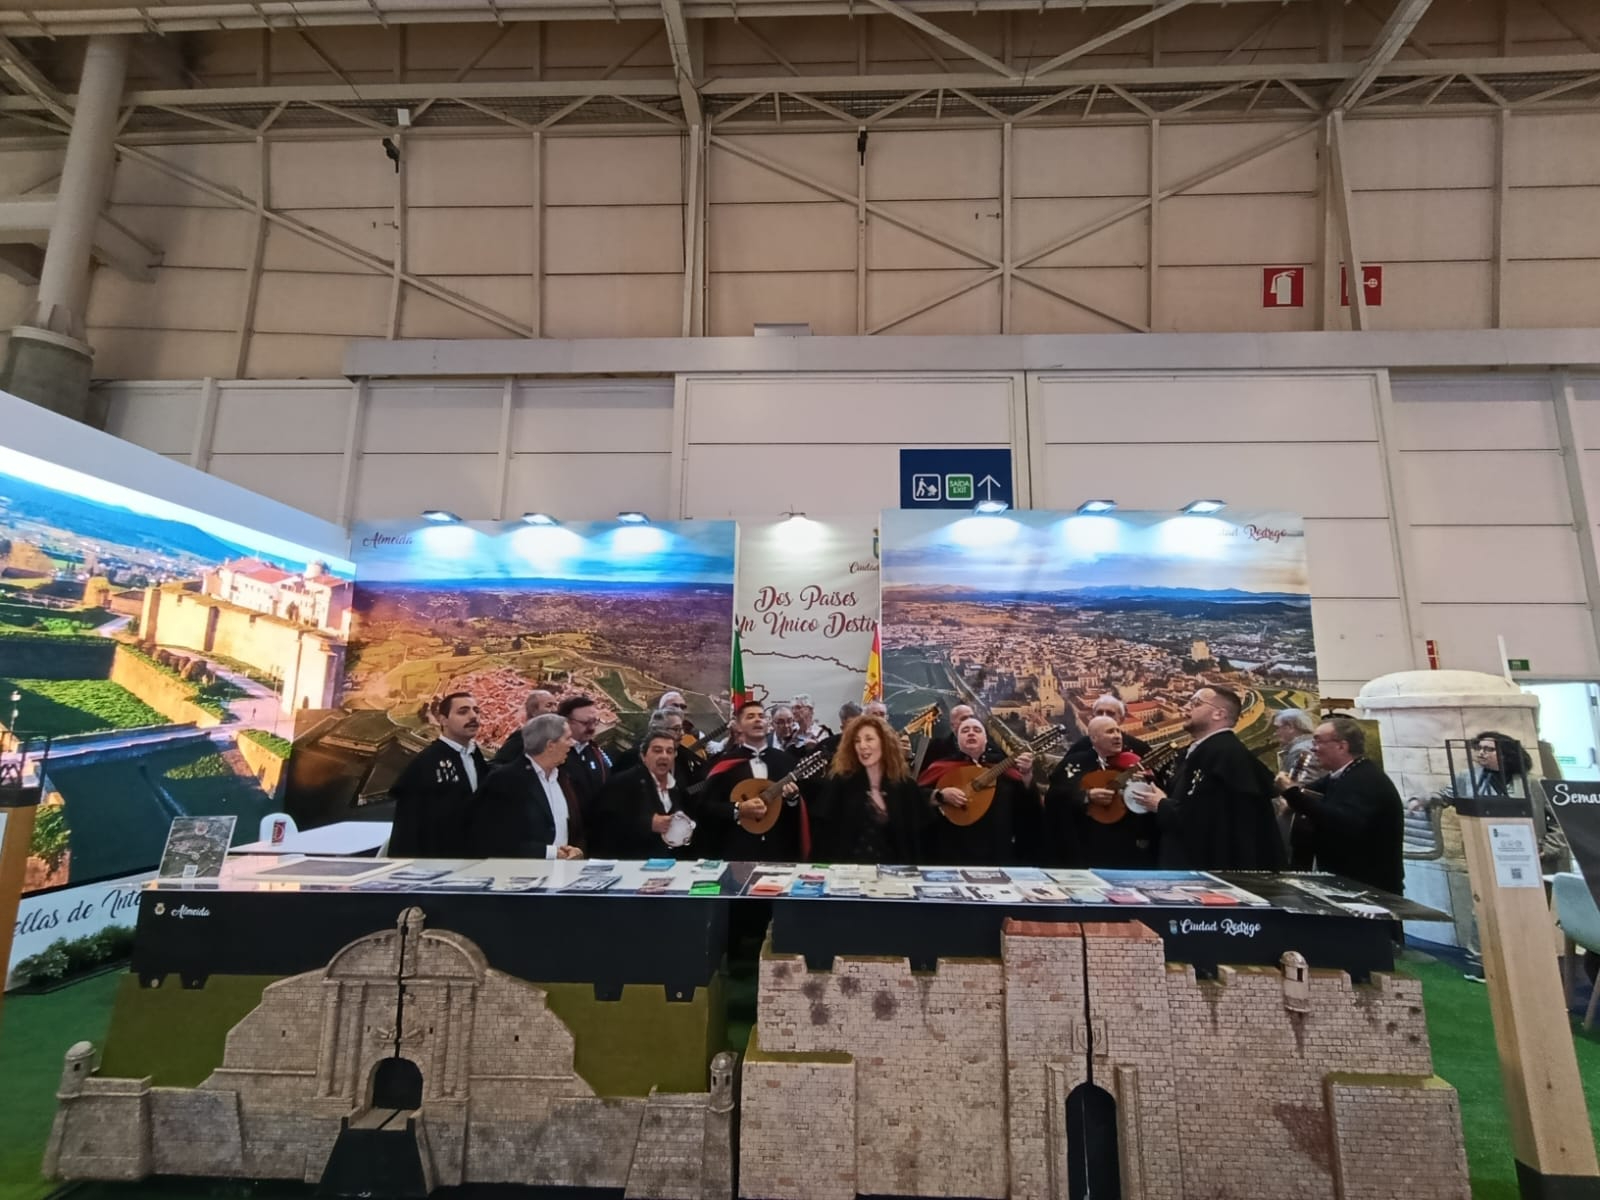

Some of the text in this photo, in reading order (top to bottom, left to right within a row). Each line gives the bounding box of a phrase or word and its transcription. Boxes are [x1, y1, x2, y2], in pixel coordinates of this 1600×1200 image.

[362, 531, 413, 549] Almeida
[753, 586, 792, 612] Dos
[1552, 783, 1600, 806] Sema
[67, 899, 93, 923] de
[170, 903, 210, 919] Almeida
[1180, 918, 1218, 934] Ciudad
